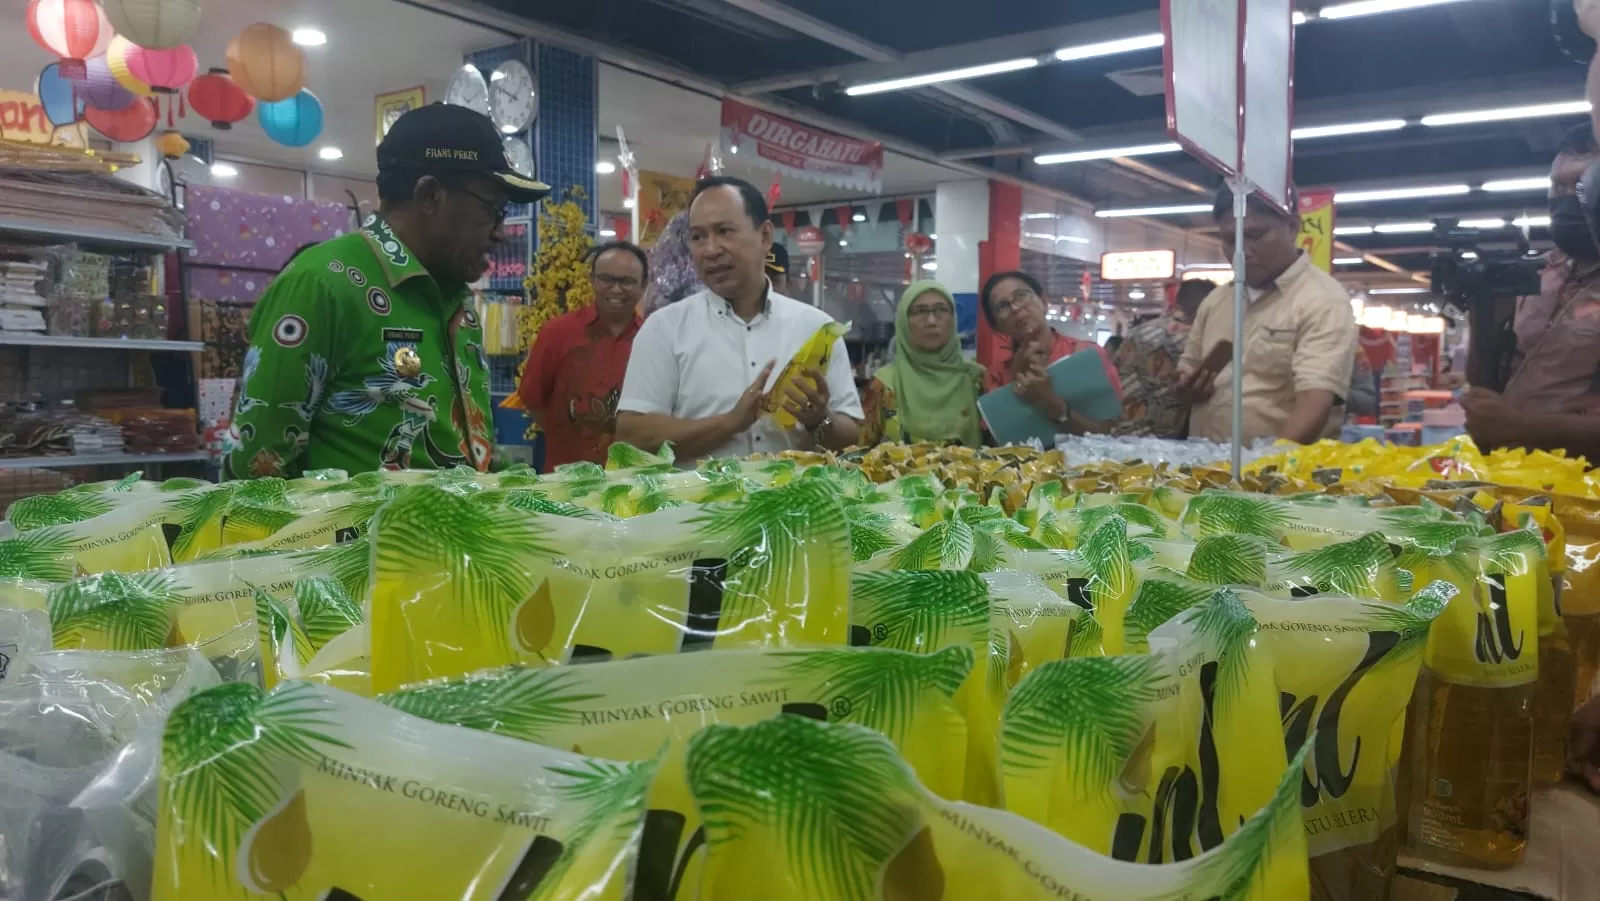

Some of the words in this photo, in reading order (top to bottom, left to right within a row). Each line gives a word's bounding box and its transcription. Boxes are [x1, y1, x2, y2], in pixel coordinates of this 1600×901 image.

[747, 113, 865, 163] DIRGAHAYU
[454, 149, 478, 161] PEKEY
[79, 535, 118, 552] MINYAK
[272, 530, 311, 550] GORENG
[312, 522, 339, 538] SAWIT
[604, 557, 660, 580] GORENG
[663, 550, 702, 568] SAWIT
[270, 580, 296, 593] SAW
[1280, 620, 1332, 633] GORENG
[581, 703, 653, 727] MINYAK
[659, 695, 734, 719] GORENG
[739, 688, 791, 708] SAWIT
[317, 756, 399, 794] MINYAK
[402, 779, 491, 818] GORENG
[494, 802, 553, 834] SAWIT
[938, 807, 1020, 862] MINYAK
